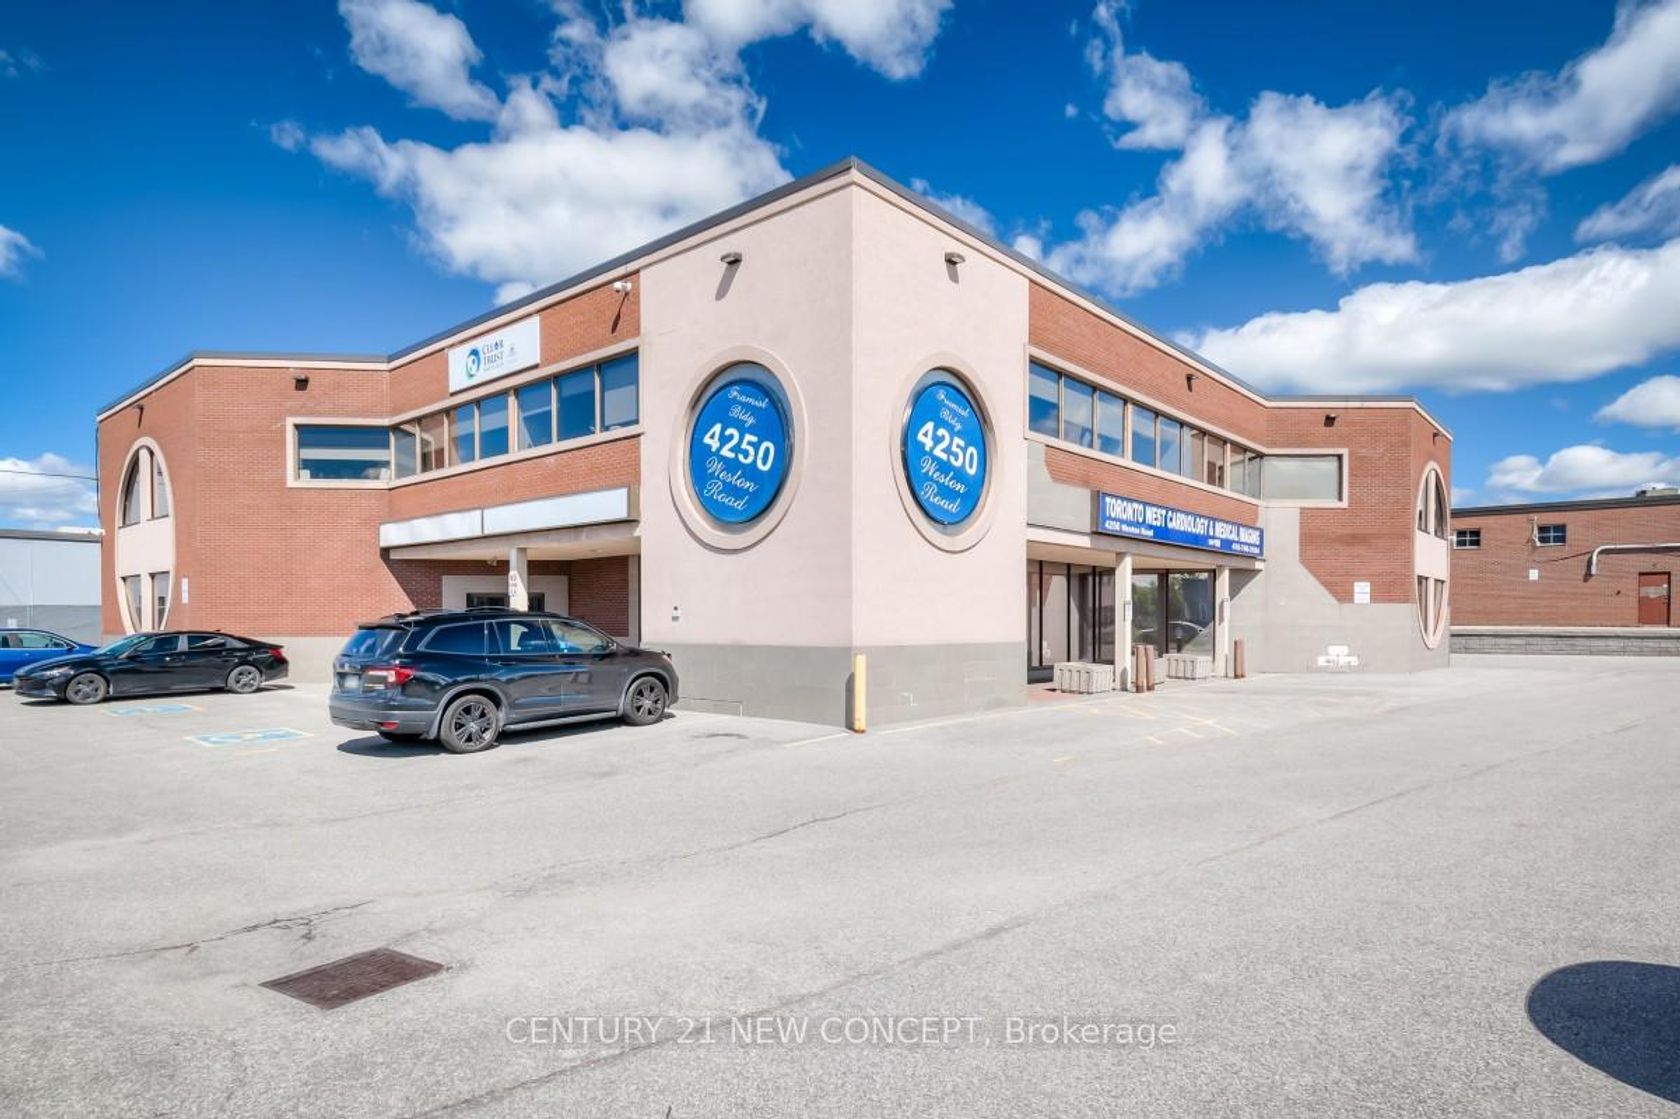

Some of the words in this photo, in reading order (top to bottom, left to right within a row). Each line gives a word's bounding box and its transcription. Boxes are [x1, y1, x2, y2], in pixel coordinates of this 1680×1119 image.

[703, 423, 775, 472] 4250
[916, 420, 978, 477] 4250
[706, 456, 759, 493] Weston
[920, 455, 968, 494] Weston
[703, 479, 751, 511] Road
[921, 482, 961, 513] Road
[1105, 497, 1144, 523] TORONTO
[1146, 506, 1166, 528] WEST
[1167, 510, 1208, 536] CARDIOLOGY
[1209, 522, 1214, 536] &
[1215, 521, 1239, 541] MEDICAL
[1240, 526, 1260, 545] IMAGING
